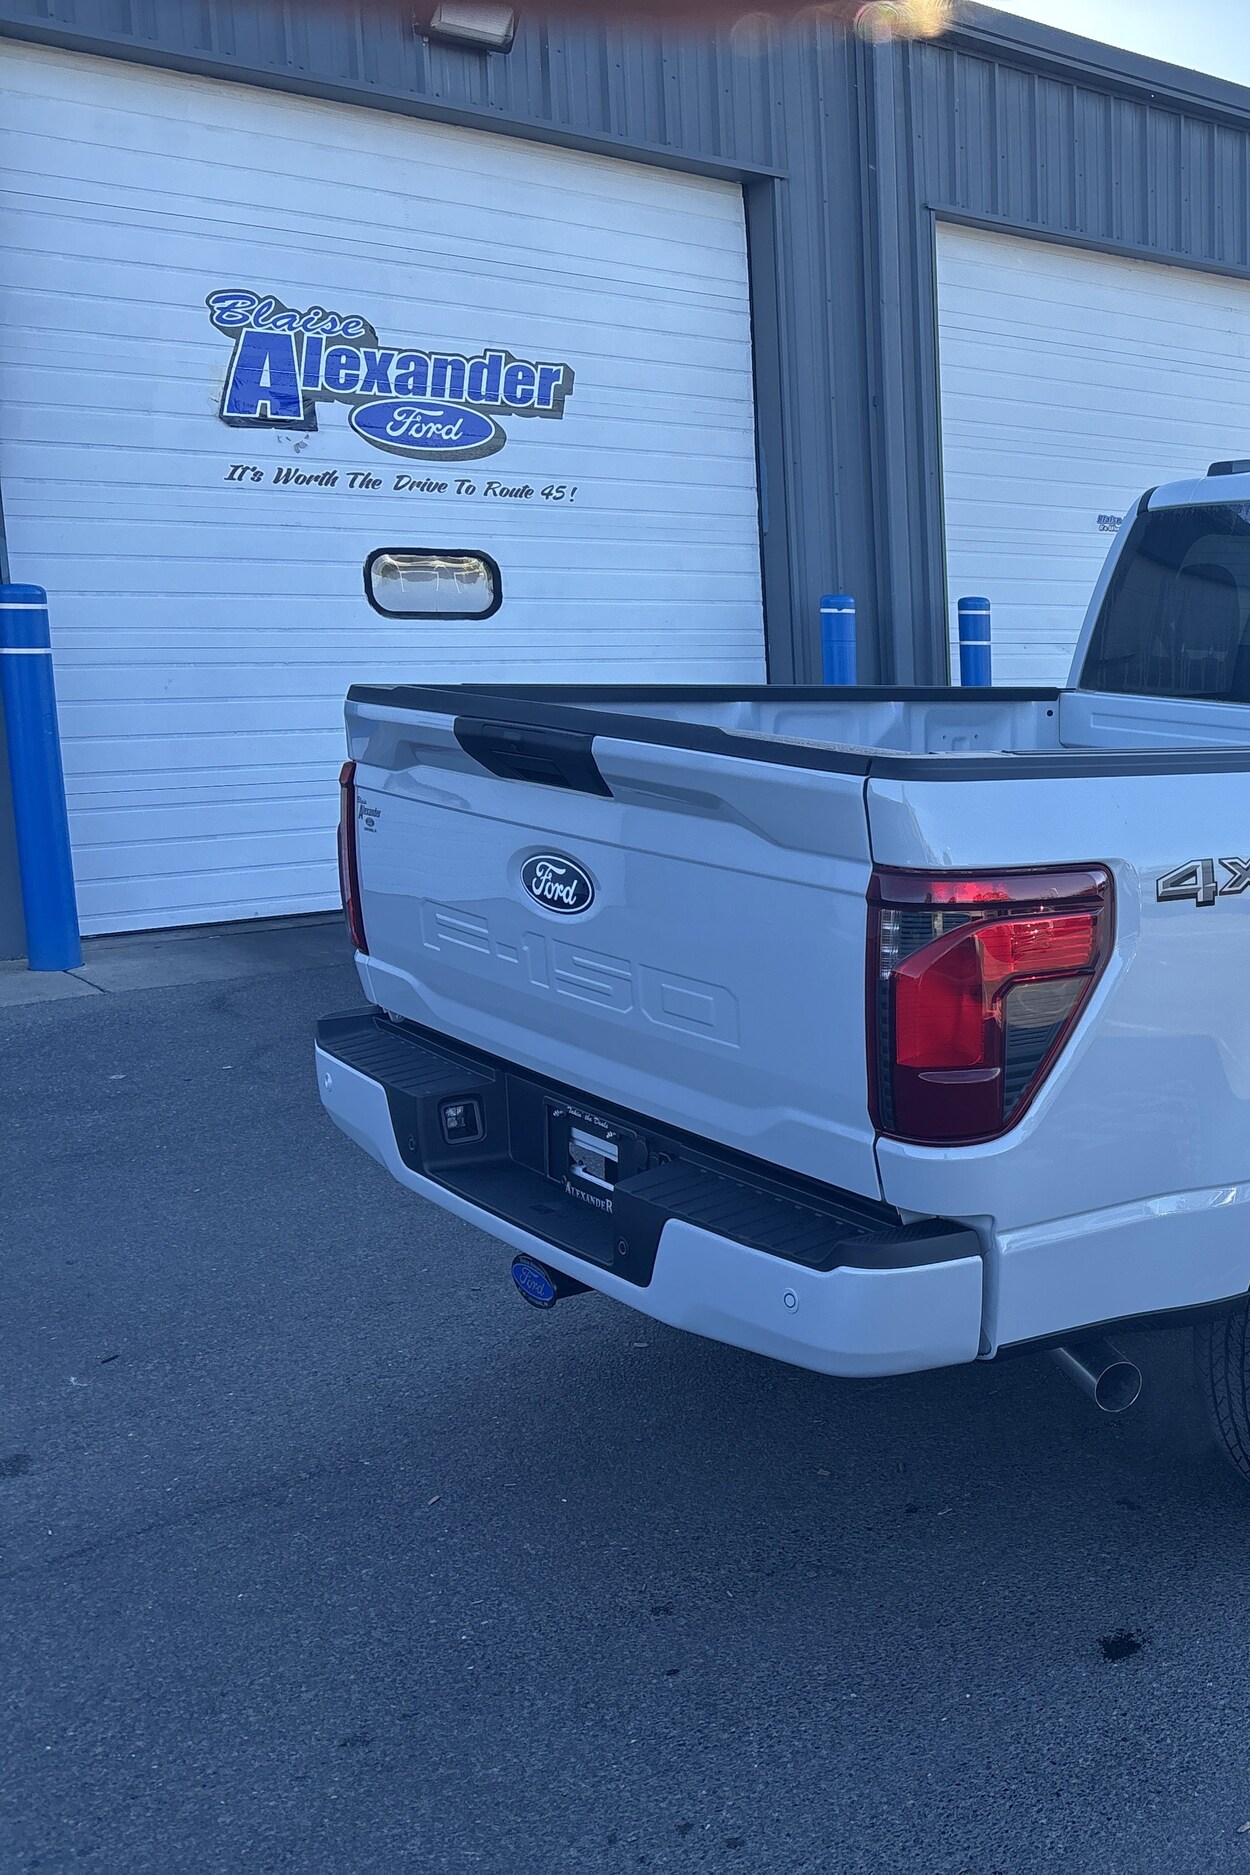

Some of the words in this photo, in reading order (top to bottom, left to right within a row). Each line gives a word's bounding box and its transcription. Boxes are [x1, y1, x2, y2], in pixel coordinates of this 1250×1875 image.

[207, 292, 366, 338] Blaise
[223, 328, 565, 421] Alexander
[386, 406, 464, 441] Ford
[224, 464, 264, 483] It's
[273, 466, 339, 488] Worth
[346, 471, 383, 490] The
[392, 474, 449, 495] Drive
[454, 479, 476, 496] To
[483, 481, 535, 500] Route
[531, 861, 578, 905] Ford
[421, 897, 741, 1049] F-150
[520, 1266, 546, 1297] Ford
